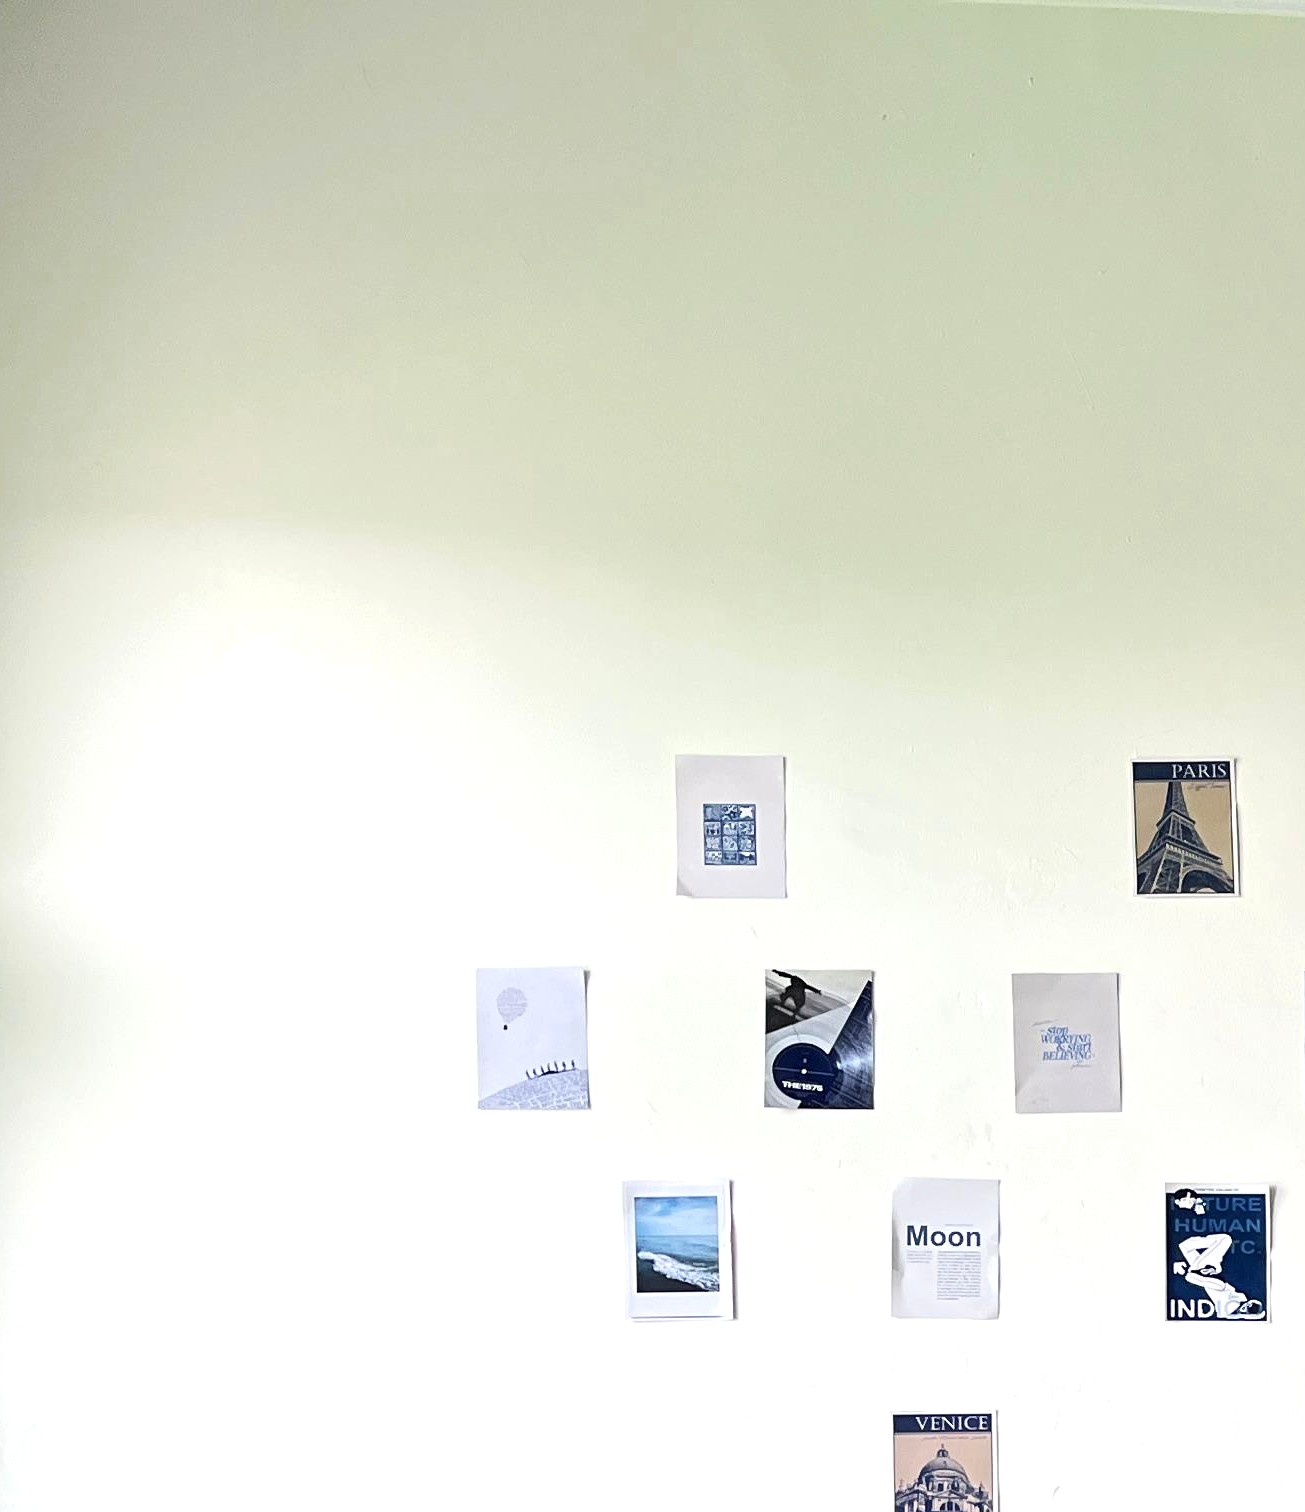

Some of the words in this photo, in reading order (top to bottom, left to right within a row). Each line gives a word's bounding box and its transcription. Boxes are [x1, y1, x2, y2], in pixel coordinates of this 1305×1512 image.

[1171, 763, 1227, 779] PARIS
[1043, 1051, 1091, 1061] BELIEVING
[1174, 1218, 1261, 1233] HUMAN
[906, 1225, 981, 1247] Moon
[915, 1416, 989, 1431] VENICE
